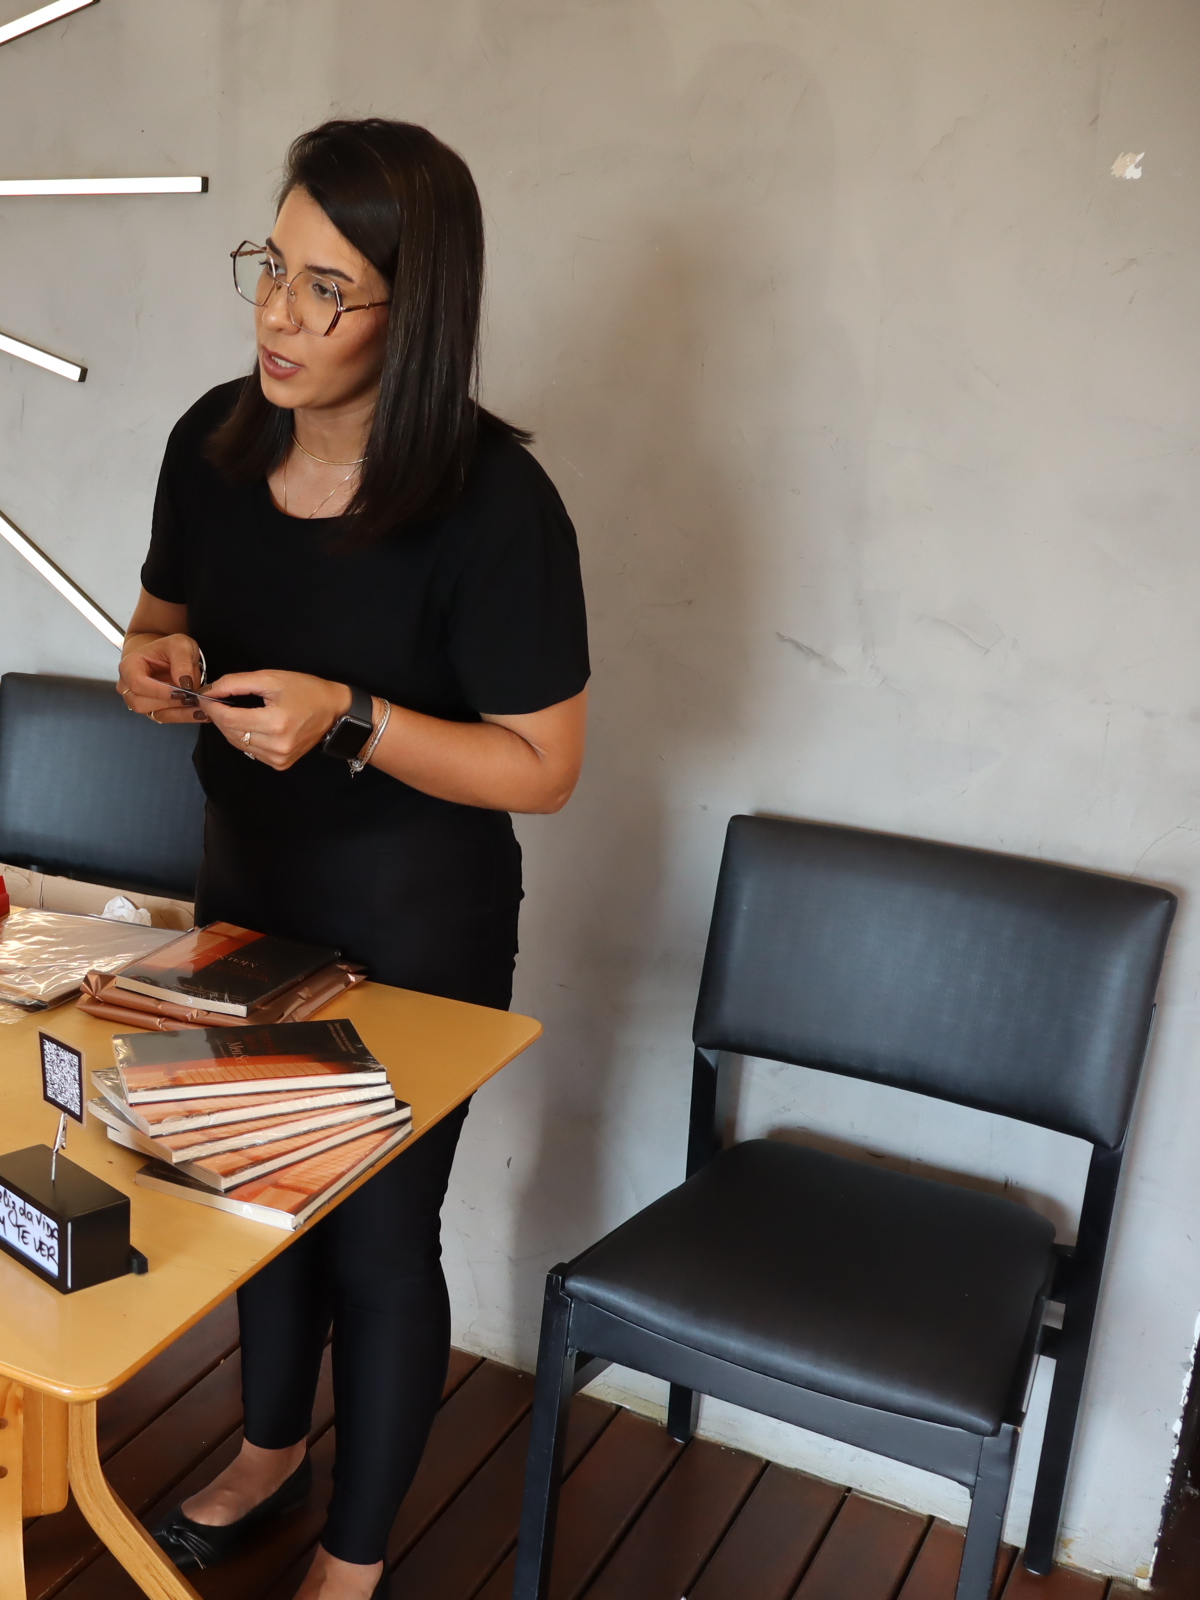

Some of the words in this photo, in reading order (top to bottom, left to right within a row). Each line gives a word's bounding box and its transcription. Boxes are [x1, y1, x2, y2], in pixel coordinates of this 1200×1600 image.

[18, 1201, 34, 1226] da
[15, 1223, 31, 1246] TE
[33, 1236, 59, 1266] VER
